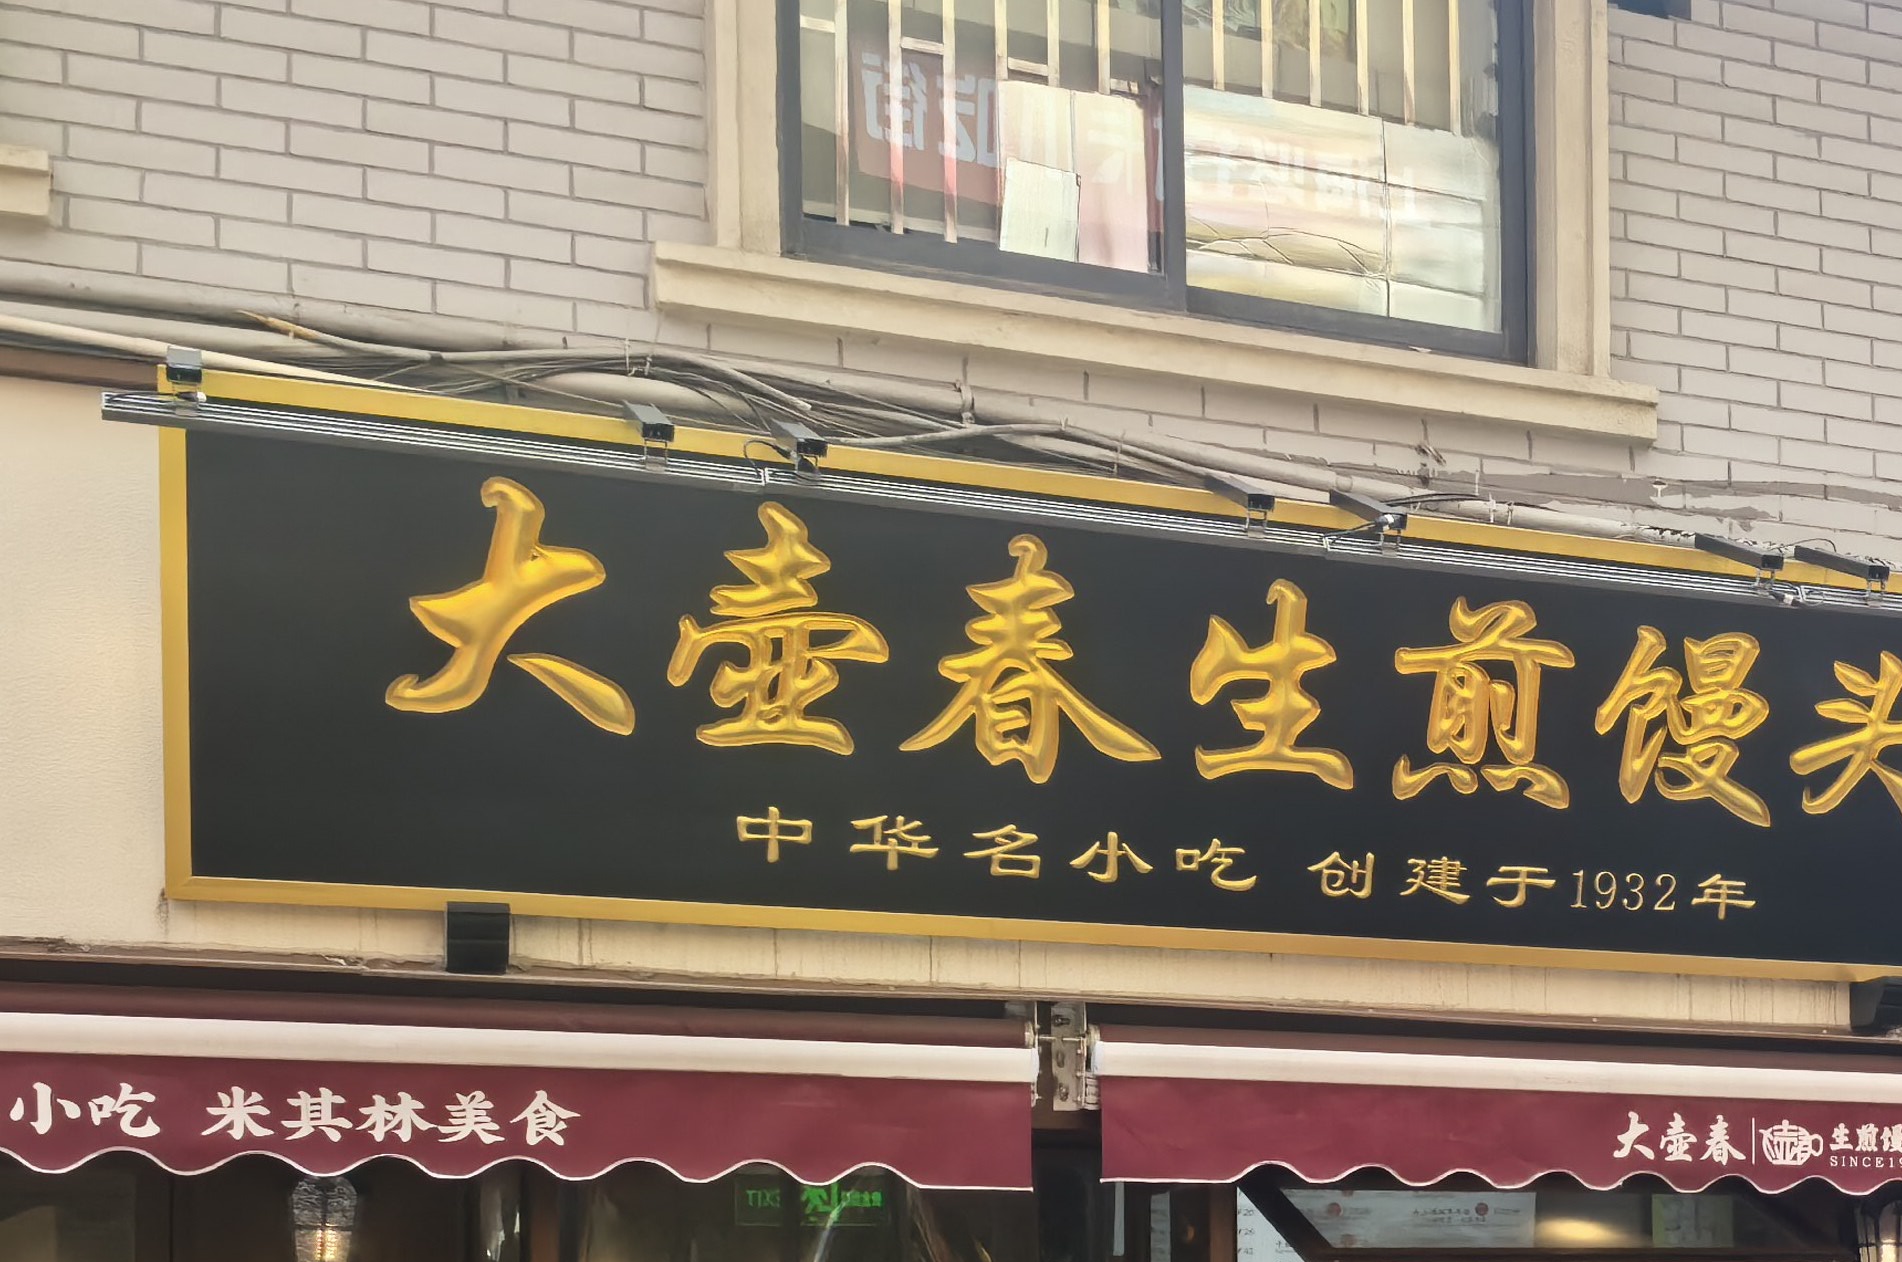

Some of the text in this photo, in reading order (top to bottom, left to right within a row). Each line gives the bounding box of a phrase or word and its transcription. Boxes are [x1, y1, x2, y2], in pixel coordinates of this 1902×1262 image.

[736, 805, 1757, 921] 中华名小吃 创建于1932年
[9, 1081, 582, 1146] 小吃 米其林美食
